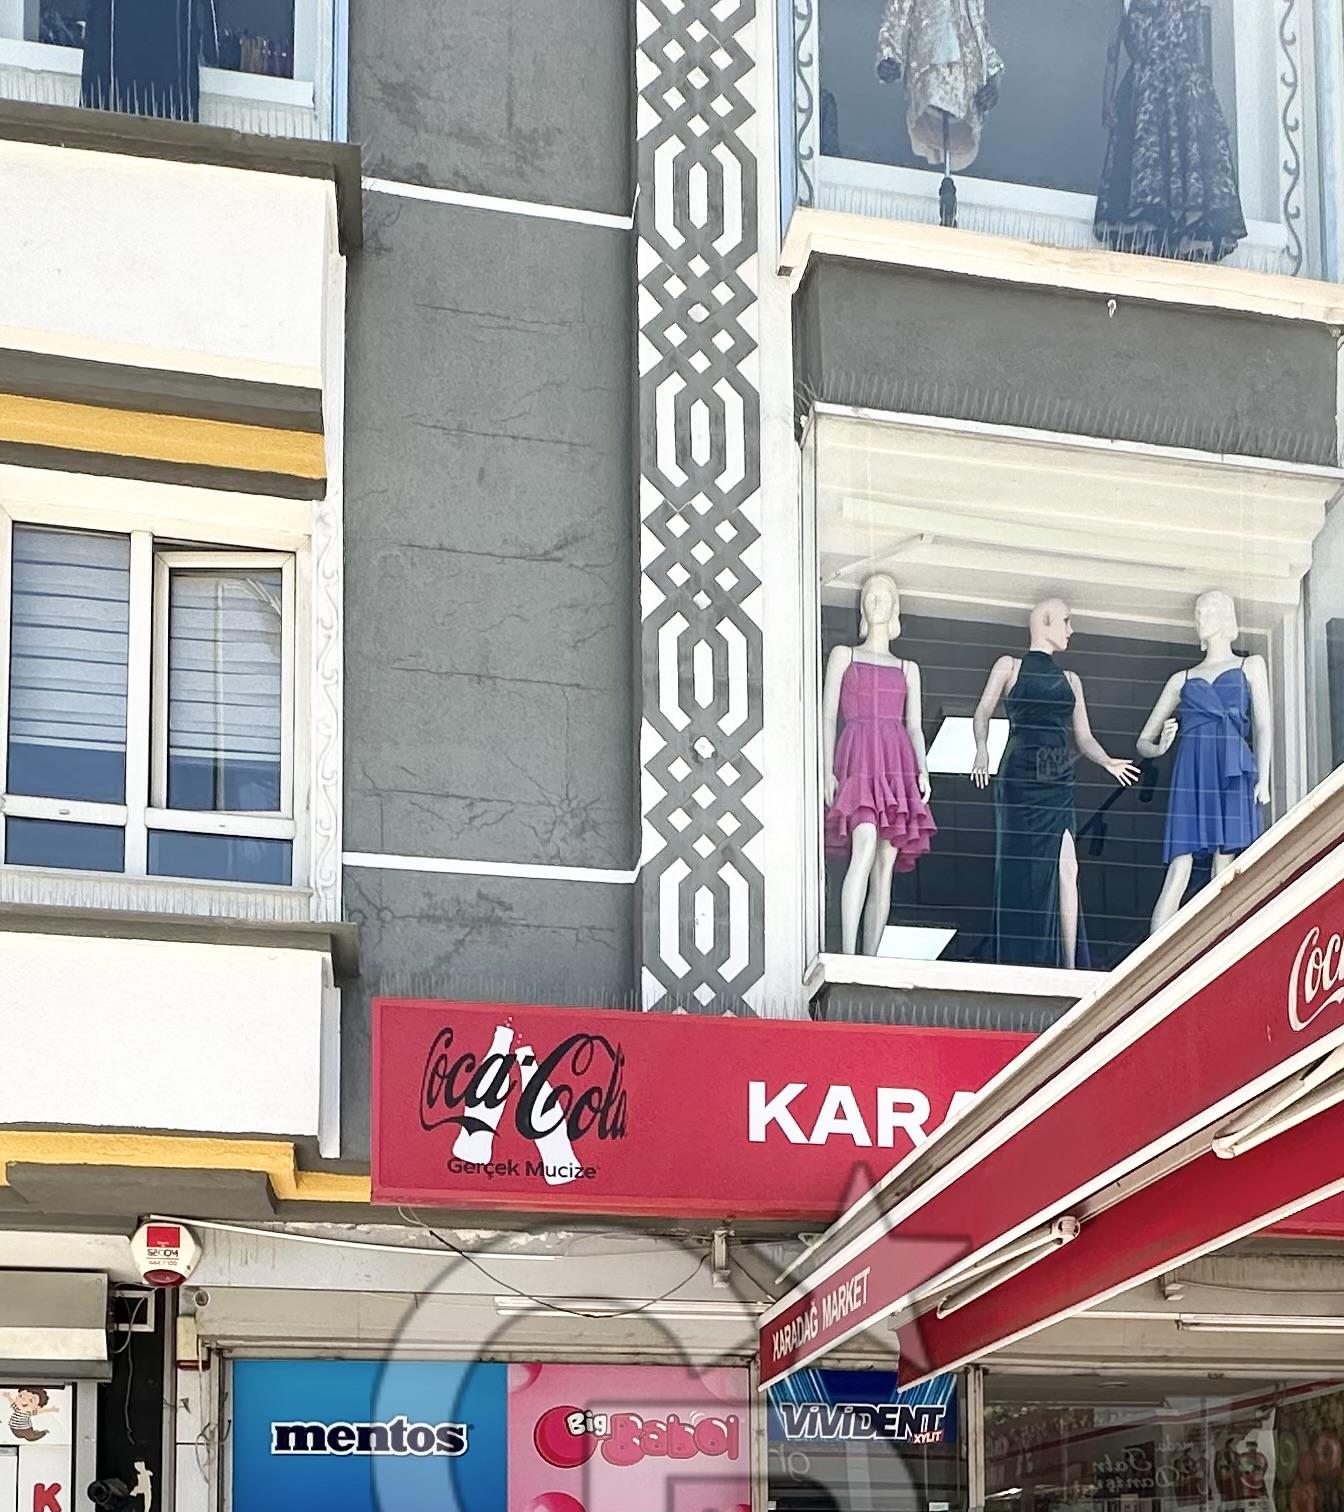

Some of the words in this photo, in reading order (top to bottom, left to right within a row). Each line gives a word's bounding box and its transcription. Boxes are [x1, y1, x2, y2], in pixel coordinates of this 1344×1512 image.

[420, 1027, 628, 1141] Coca-Cola
[447, 1159, 520, 1180] Gerçek
[525, 1160, 597, 1179] Mucize
[822, 1266, 871, 1331] MARKET
[271, 1415, 468, 1457] mentos
[566, 1411, 607, 1436] Big
[601, 1412, 739, 1466] Babol
